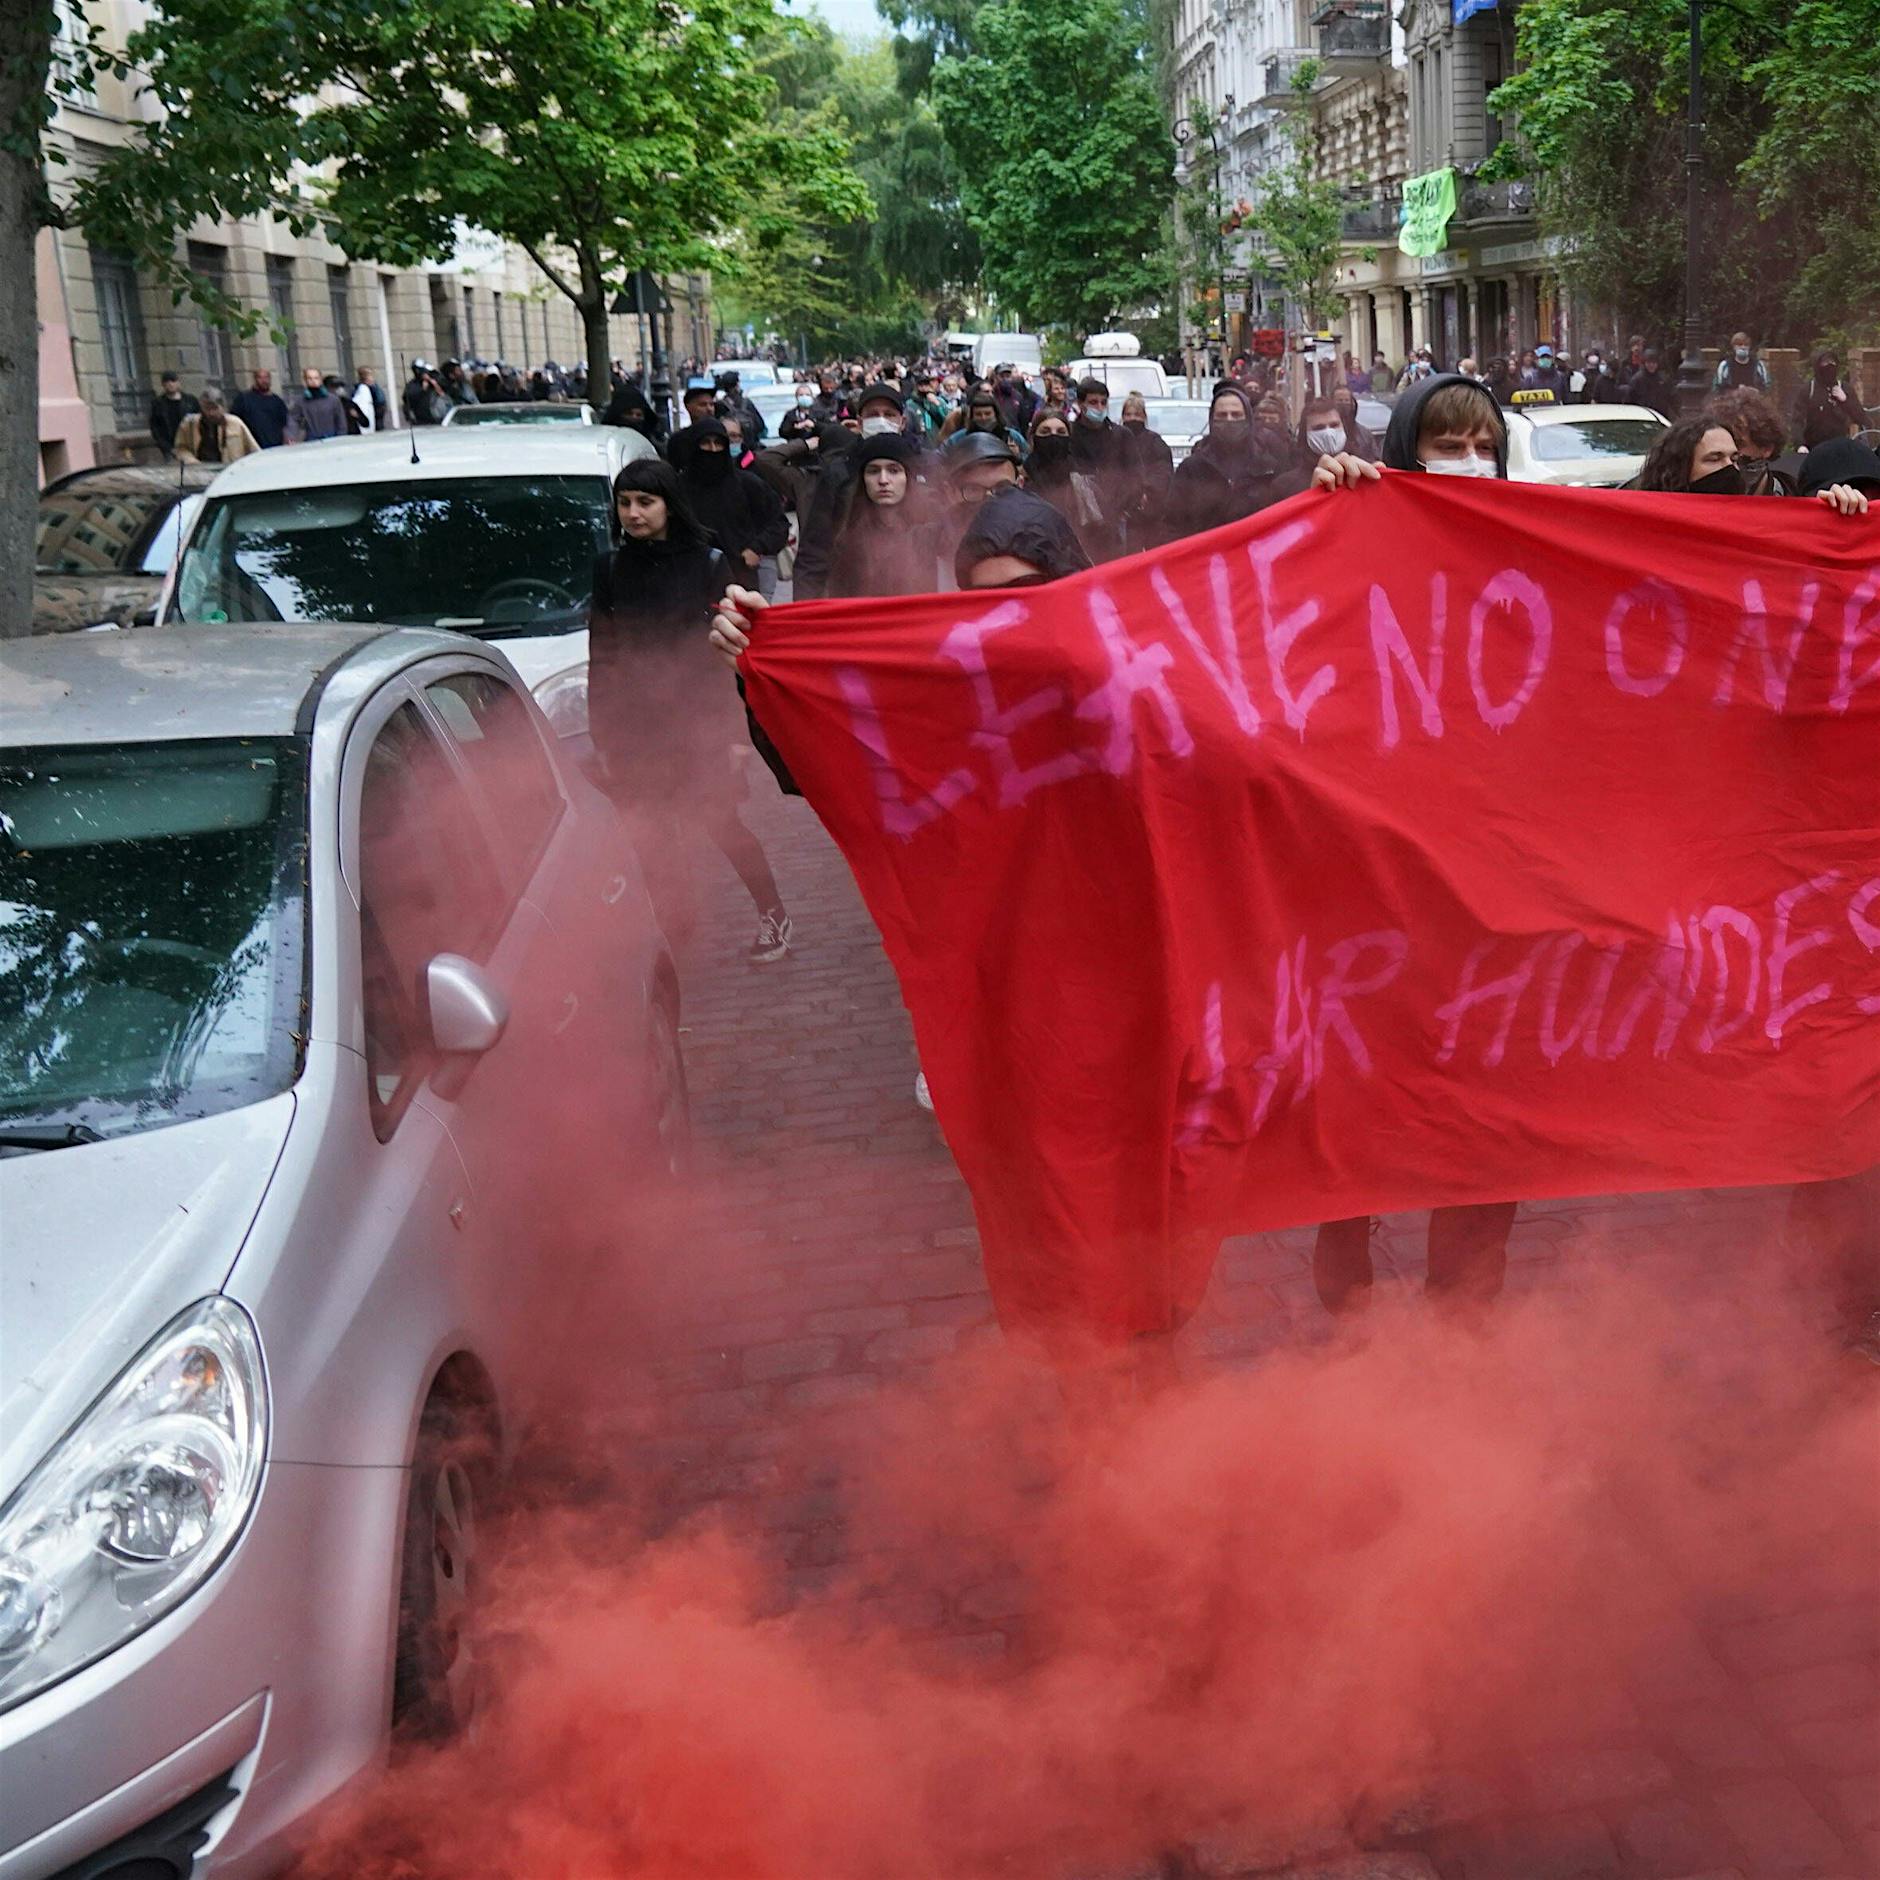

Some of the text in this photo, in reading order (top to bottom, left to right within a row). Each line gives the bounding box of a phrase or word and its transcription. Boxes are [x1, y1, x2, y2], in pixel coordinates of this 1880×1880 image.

[1521, 392, 1550, 401] TAXI
[834, 519, 1337, 843] LEAVE
[1368, 567, 1553, 749] NO
